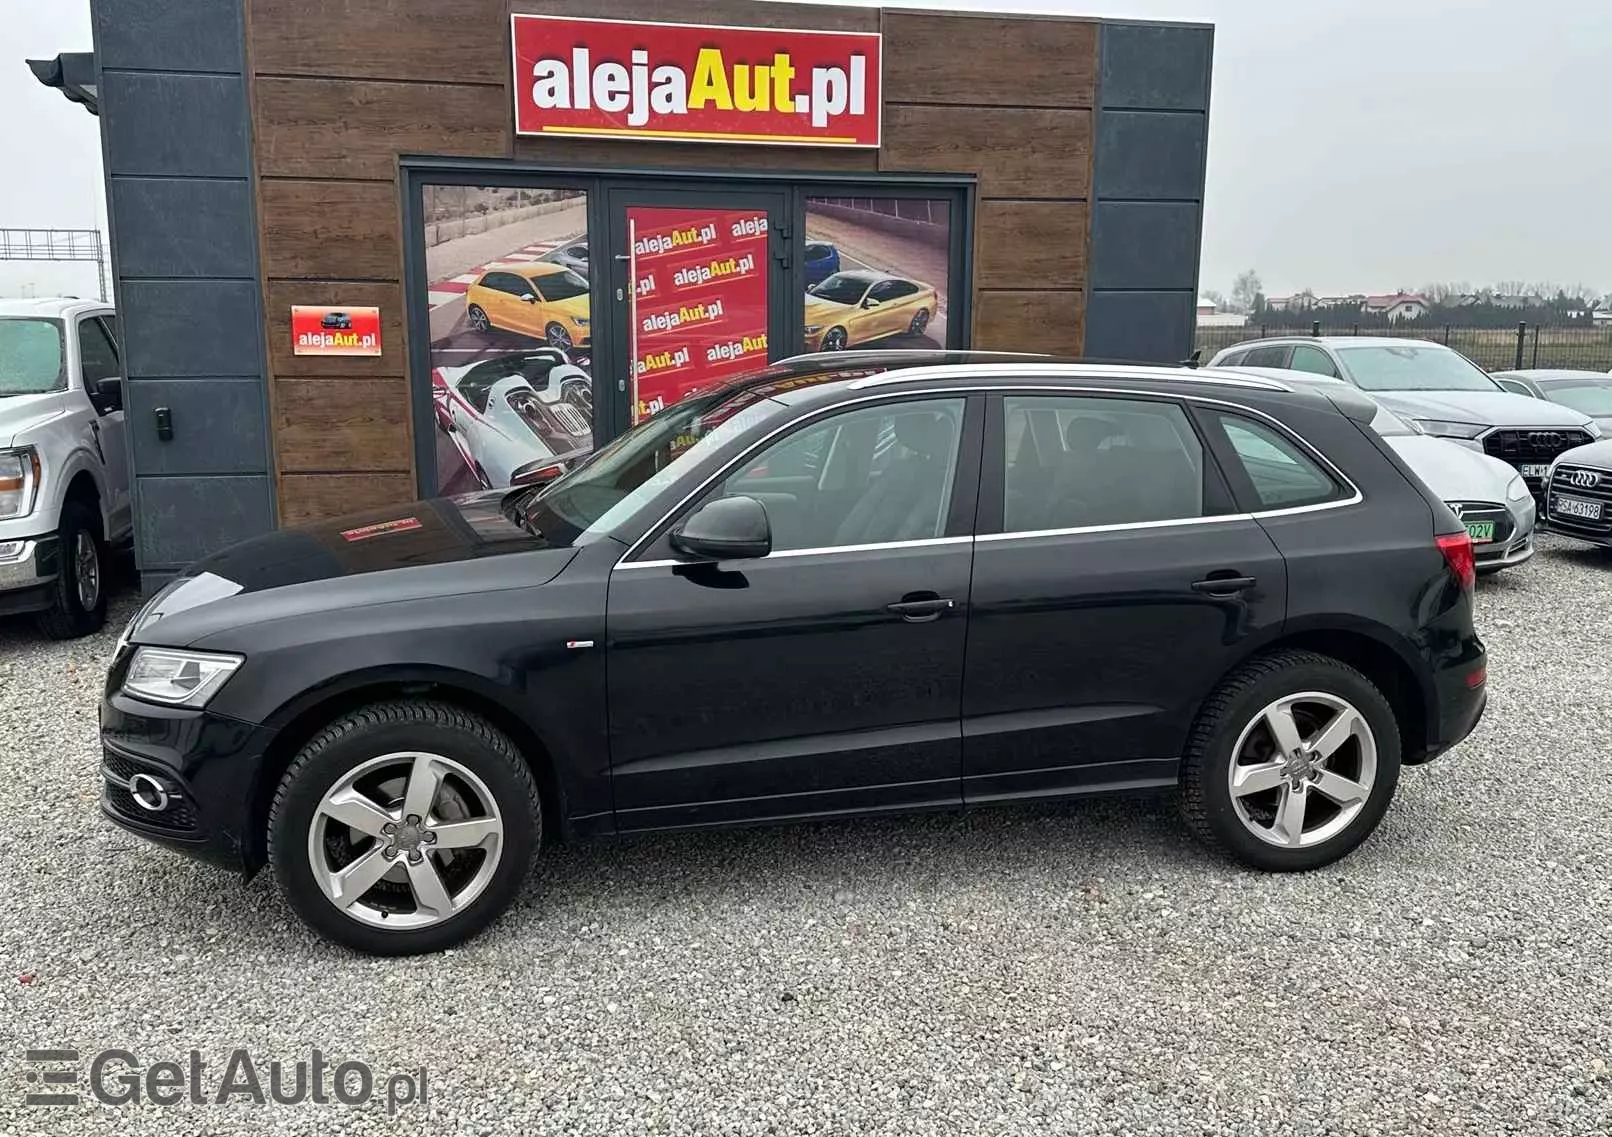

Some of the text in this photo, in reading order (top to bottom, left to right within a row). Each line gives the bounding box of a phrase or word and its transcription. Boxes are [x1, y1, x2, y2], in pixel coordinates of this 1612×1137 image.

[532, 47, 867, 128] alejaAut.pl
[636, 223, 716, 255] alejaAut.pl
[732, 217, 768, 236] aleja
[673, 254, 755, 286] alejaAut.pl
[642, 300, 724, 331] alejaAut.pl
[299, 332, 376, 348] alejaAut.pl
